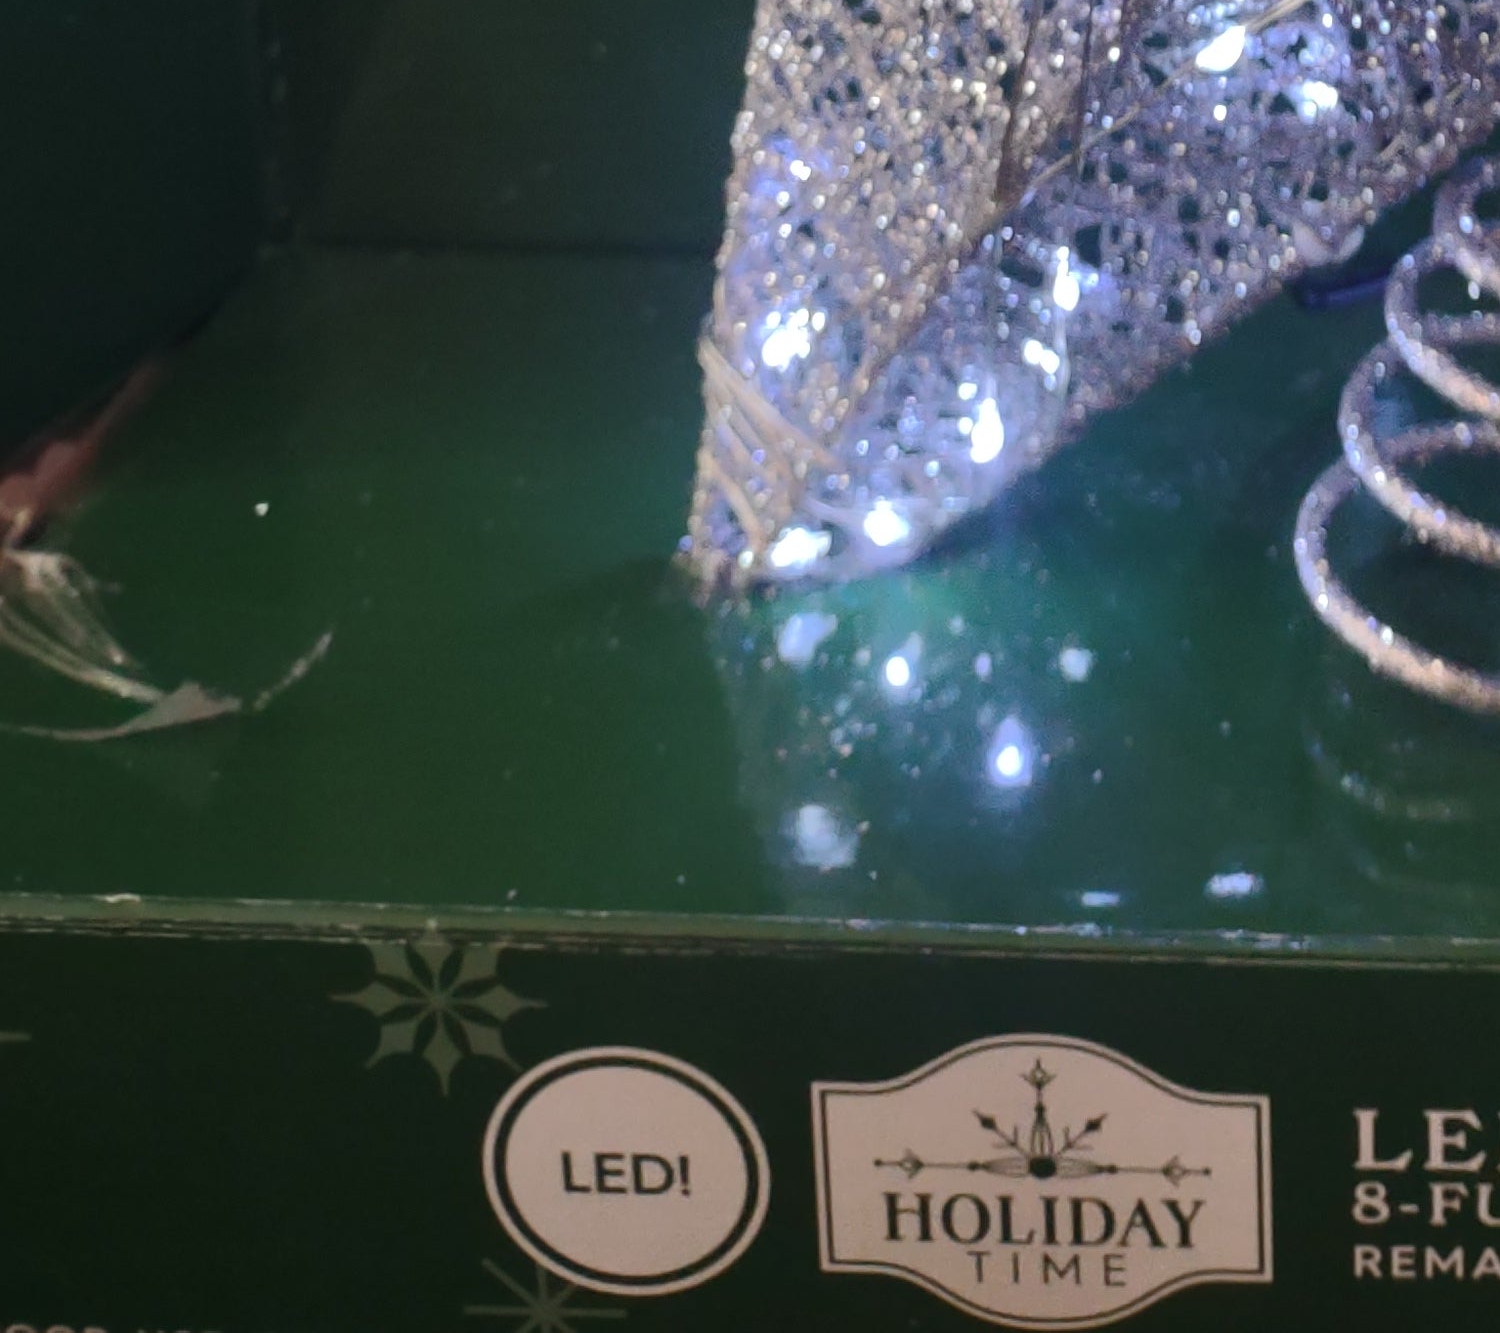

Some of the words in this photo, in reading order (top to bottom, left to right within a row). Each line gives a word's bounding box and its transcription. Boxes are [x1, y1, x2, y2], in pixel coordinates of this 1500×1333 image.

[561, 1150, 693, 1200] LED!
[883, 1191, 1206, 1251] HOLIDAY
[967, 1249, 1128, 1289] TIME
